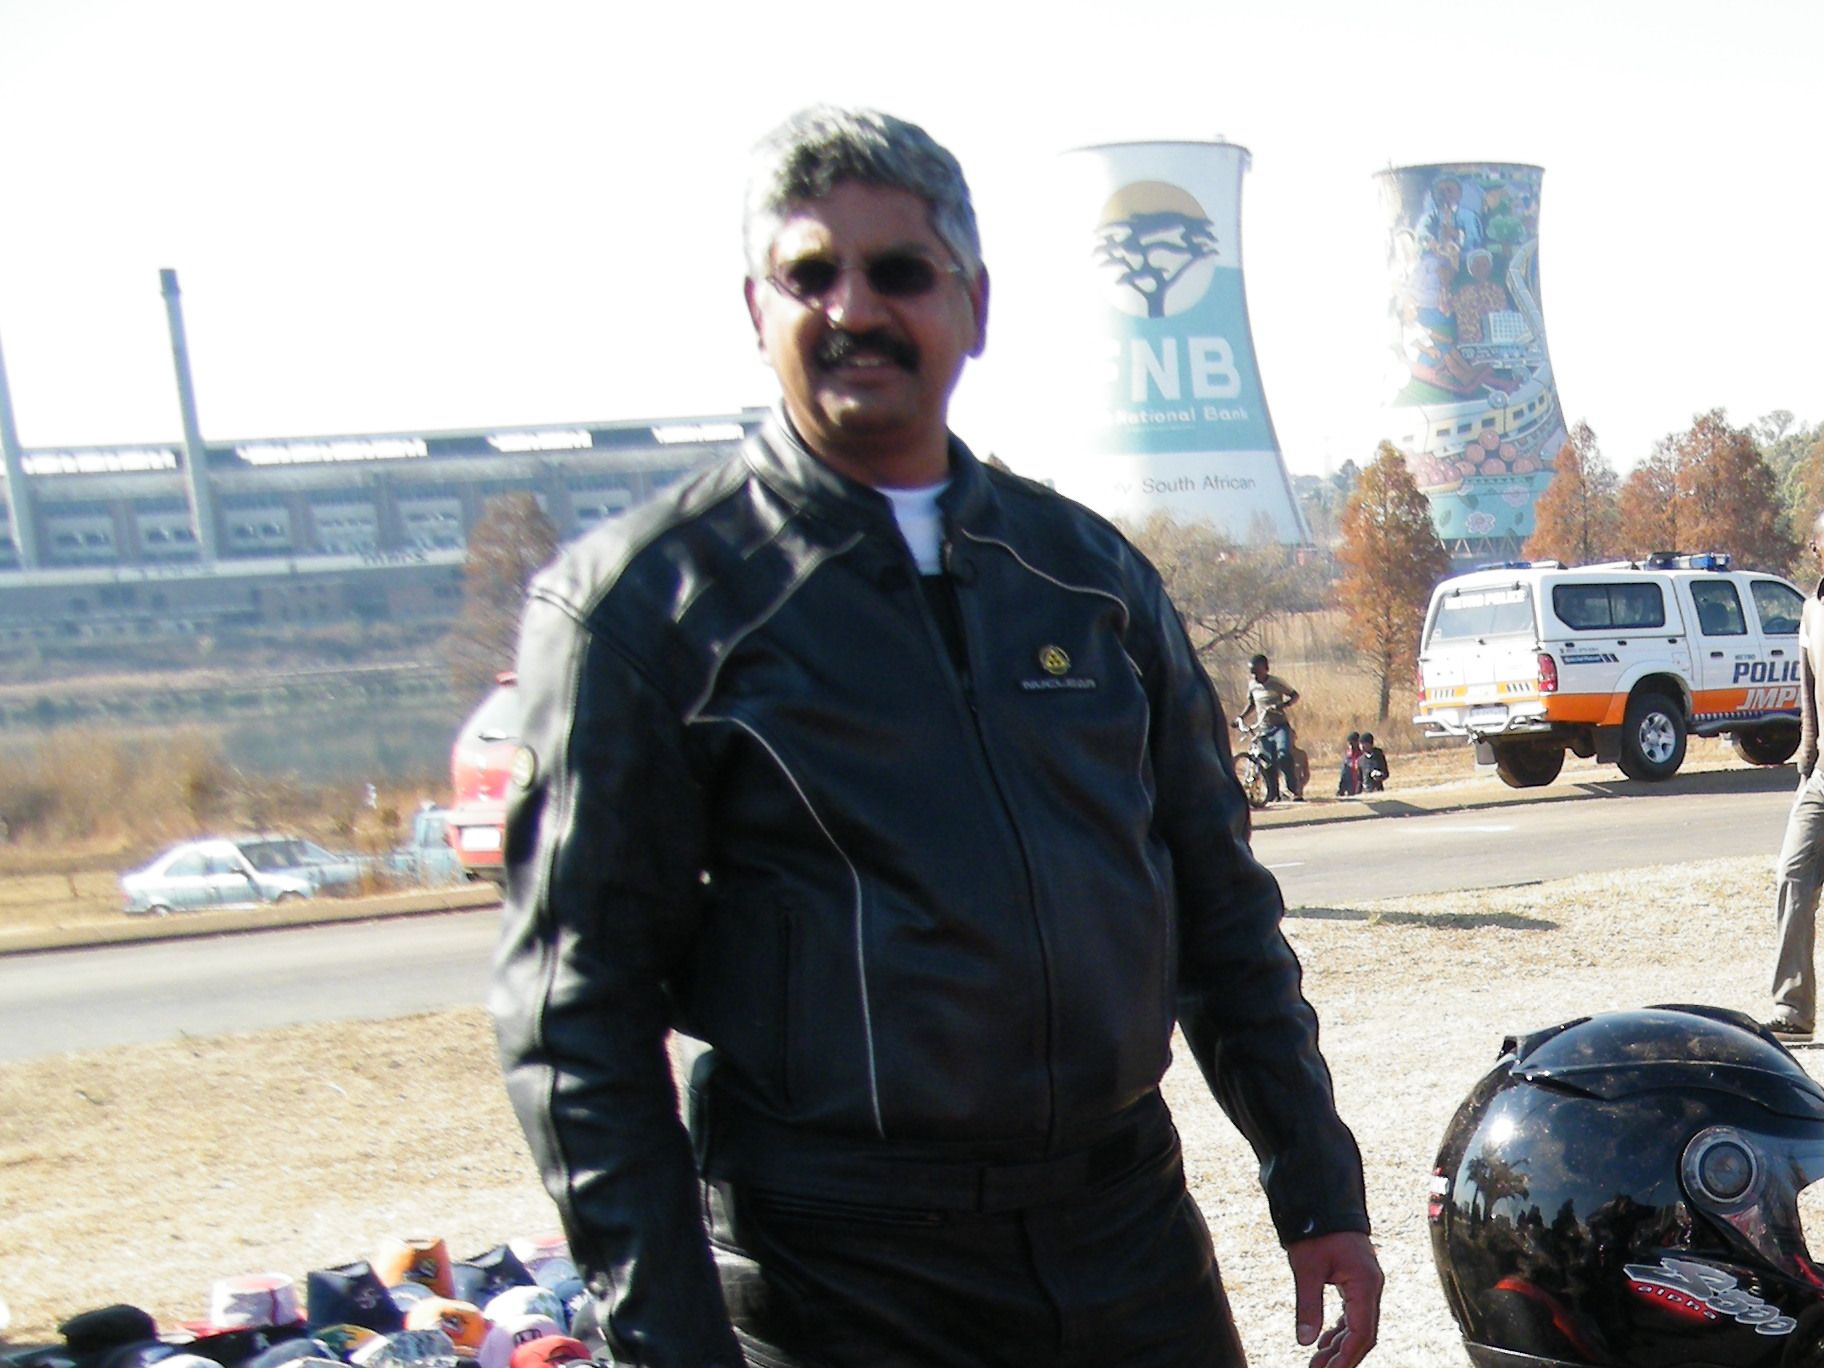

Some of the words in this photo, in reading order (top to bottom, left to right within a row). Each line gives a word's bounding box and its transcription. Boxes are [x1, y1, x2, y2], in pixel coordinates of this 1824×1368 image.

[1203, 405, 1249, 422] Bank
[1142, 476, 1196, 495] South
[1202, 474, 1256, 491] African
[1637, 1285, 1717, 1320] alpha
